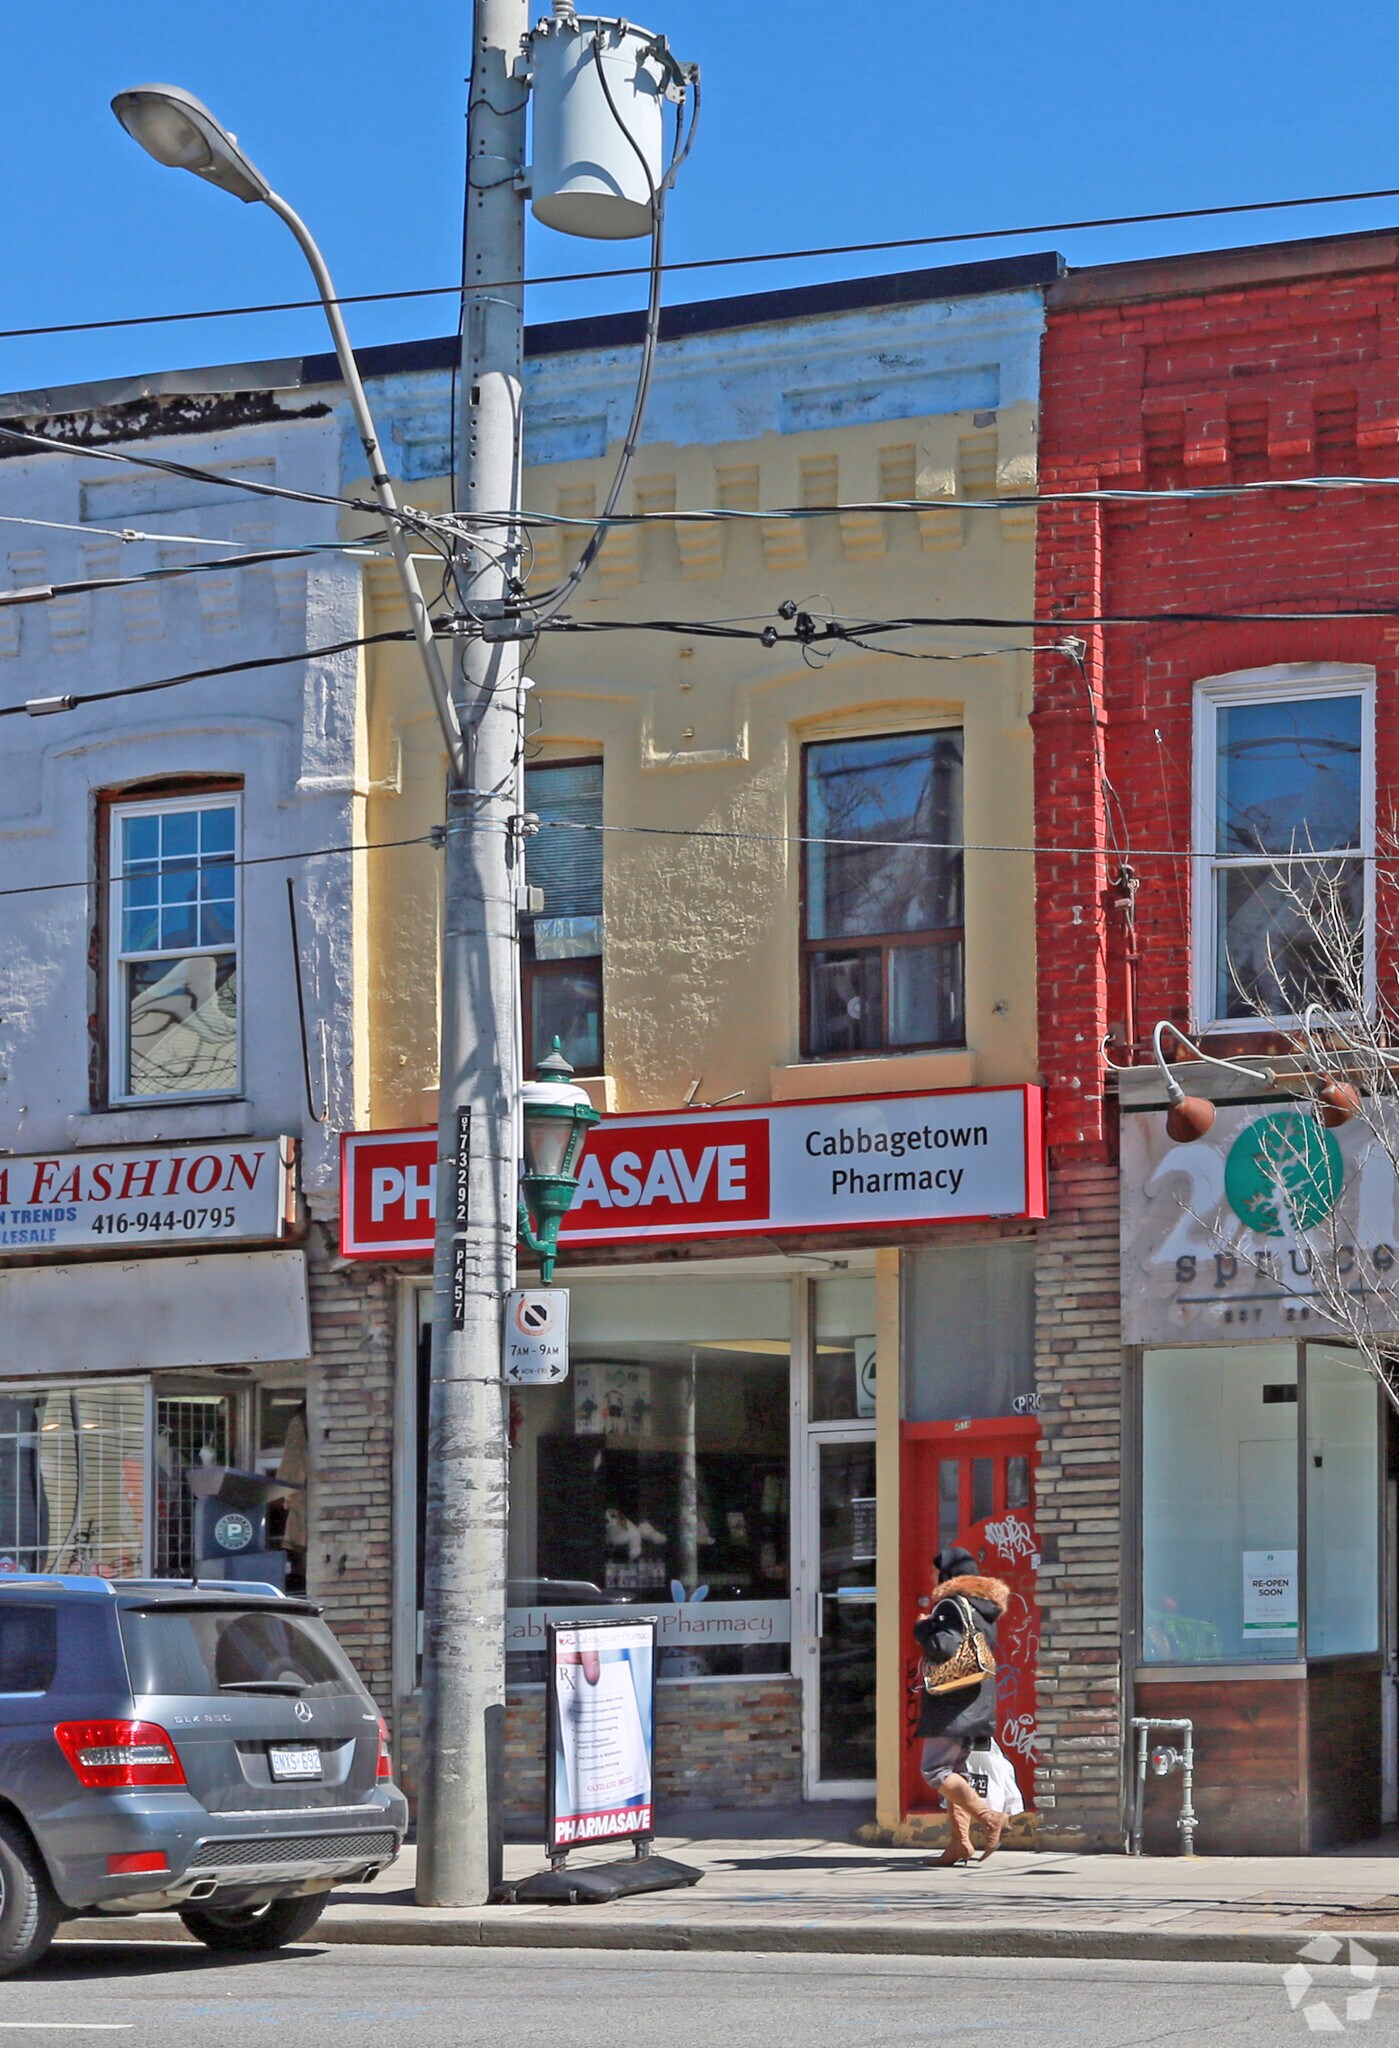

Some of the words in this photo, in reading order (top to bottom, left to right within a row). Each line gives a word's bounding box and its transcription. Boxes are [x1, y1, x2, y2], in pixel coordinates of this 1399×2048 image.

[805, 1125, 988, 1157] Cabbagetown
[27, 1152, 265, 1204] FASHION
[371, 1143, 747, 1222] PHASAVE
[832, 1168, 964, 1195] Pharmacy
[11, 1207, 77, 1224] TRENDS
[92, 1206, 236, 1234] 416-944-0795
[511, 1344, 529, 1356] 7AM
[539, 1343, 559, 1356] 9AM
[228, 1523, 242, 1537] P
[1252, 1579, 1289, 1588] RE-OPEN
[1258, 1588, 1283, 1596] SOON
[662, 1609, 773, 1640] Pharmacy
[301, 1752, 321, 1770] 692
[555, 1808, 650, 1843] PHARMASAVE
